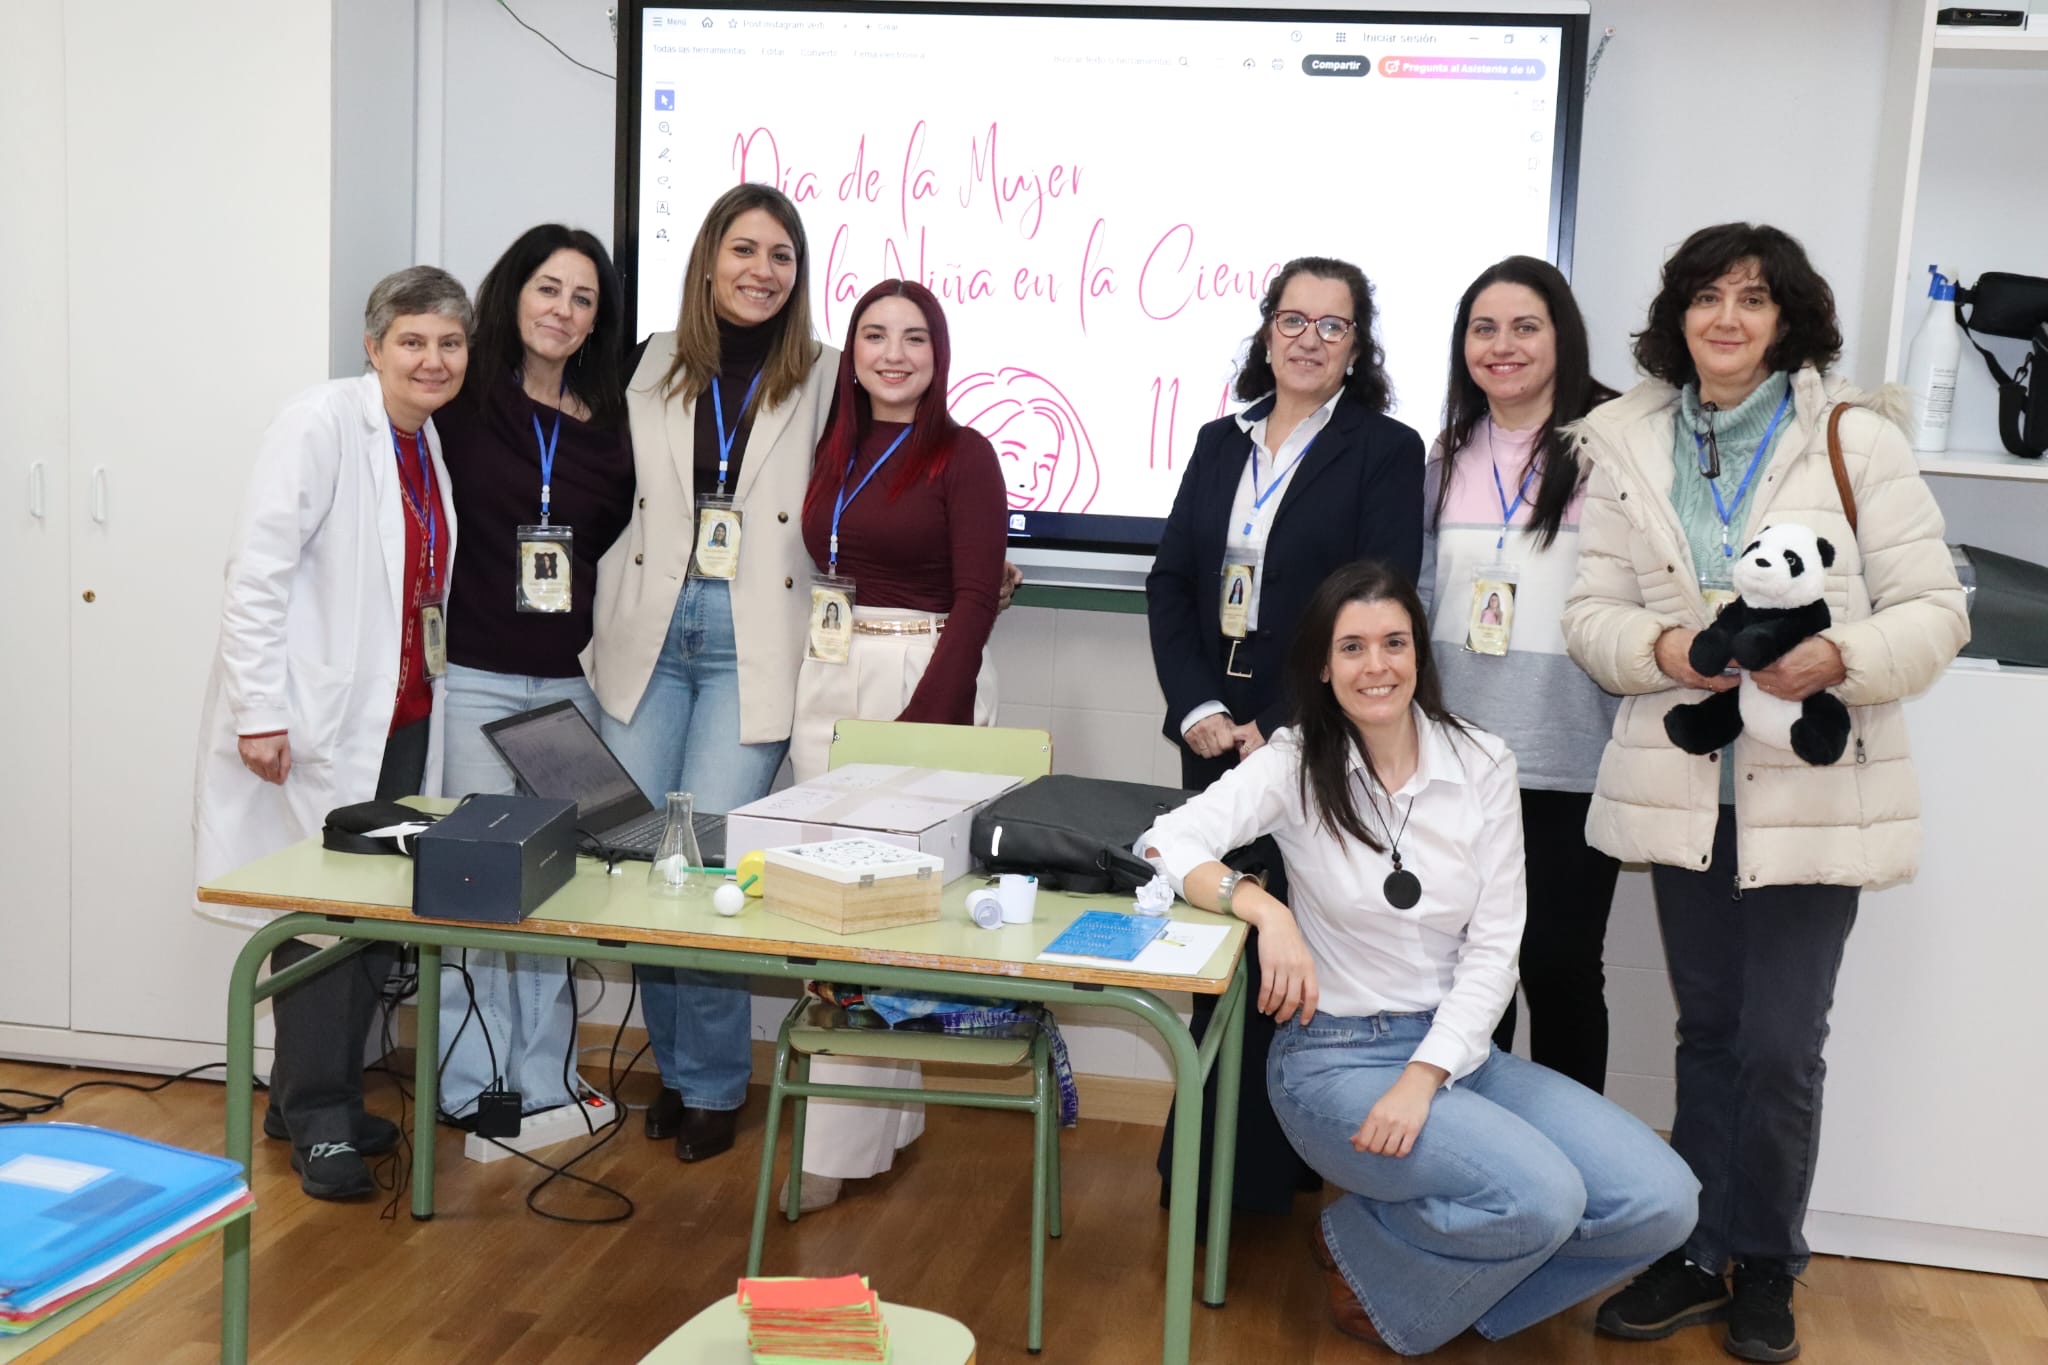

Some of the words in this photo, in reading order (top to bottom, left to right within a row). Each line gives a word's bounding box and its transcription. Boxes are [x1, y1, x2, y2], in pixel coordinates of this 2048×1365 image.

[1363, 31, 1396, 43] Iniciar
[1400, 31, 1437, 44] sesión
[653, 44, 676, 53] Todas
[1311, 59, 1361, 71] Compartir
[1402, 62, 1448, 74] Pregunta
[1450, 63, 1460, 74] al
[1461, 63, 1508, 75] Asistente
[1510, 64, 1523, 75] de
[1525, 65, 1537, 75] IA
[732, 126, 821, 202] Día
[838, 133, 887, 203] de
[901, 119, 940, 240] la
[959, 120, 1086, 241] Mujer
[824, 223, 862, 340] la
[883, 225, 995, 304] Niña
[1013, 266, 1063, 304] en
[1079, 217, 1118, 337] la
[1138, 223, 1281, 321] Cienc
[1148, 375, 1181, 471] 11
